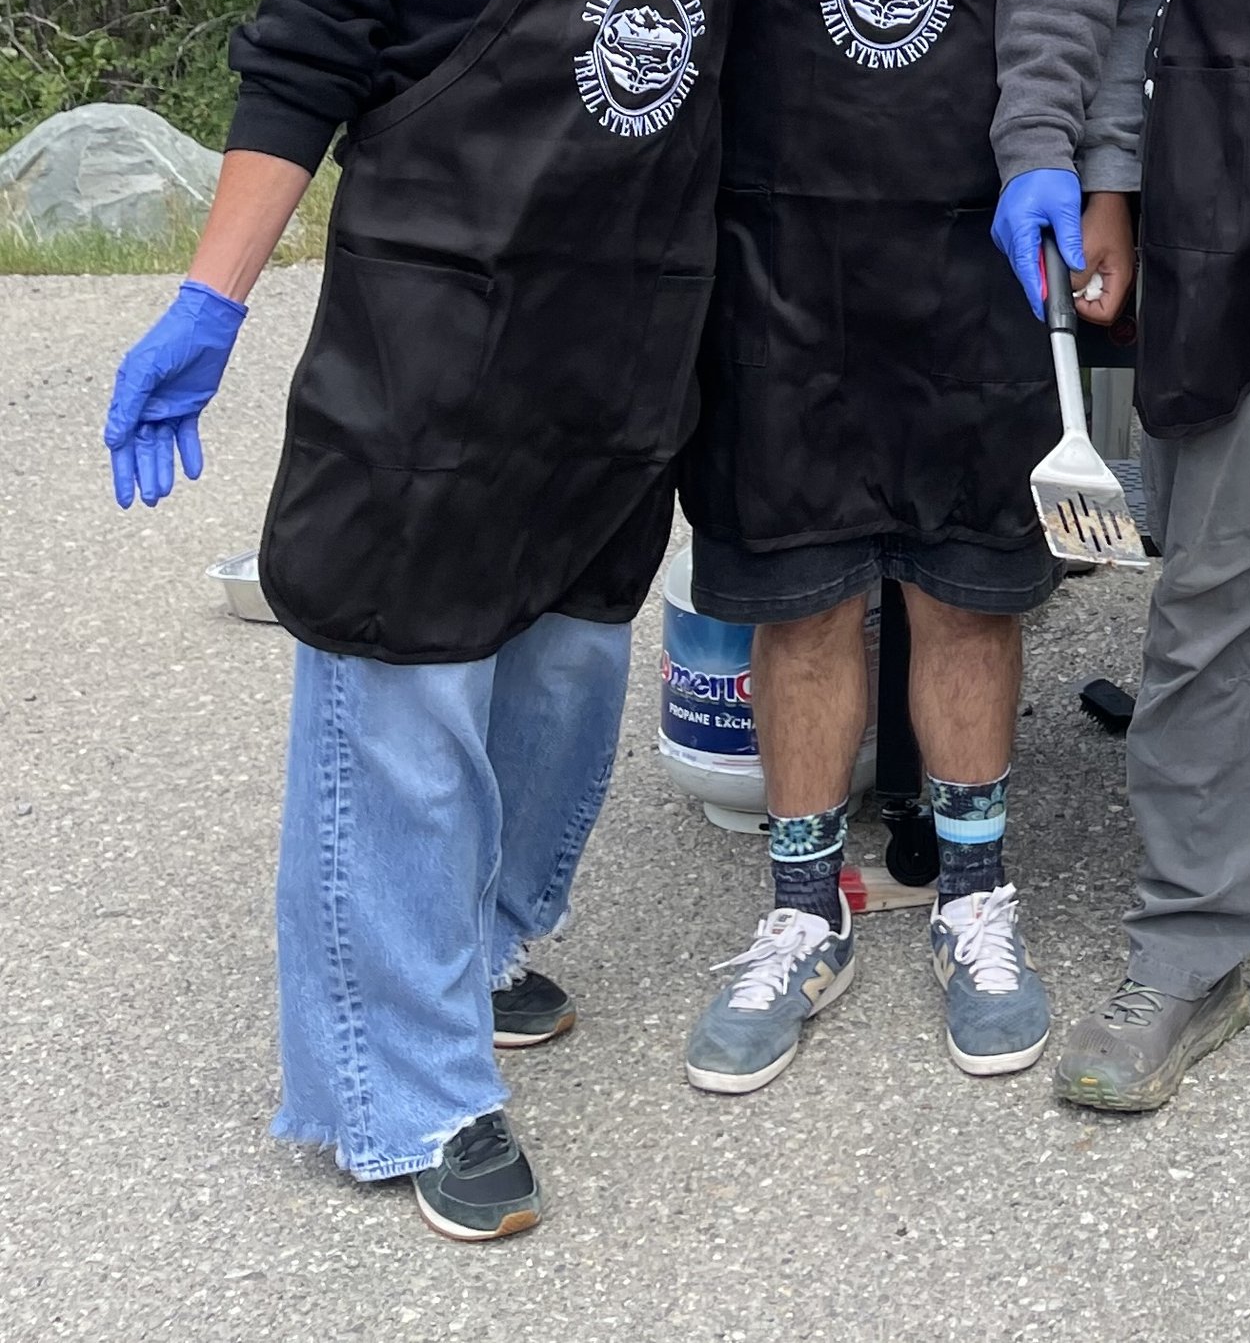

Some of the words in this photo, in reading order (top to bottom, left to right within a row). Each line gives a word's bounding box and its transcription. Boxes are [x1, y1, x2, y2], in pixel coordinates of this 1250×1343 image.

[573, 50, 606, 114] TRAIL
[598, 61, 700, 138] STEWARDSHIP
[668, 702, 711, 726] PROPANE
